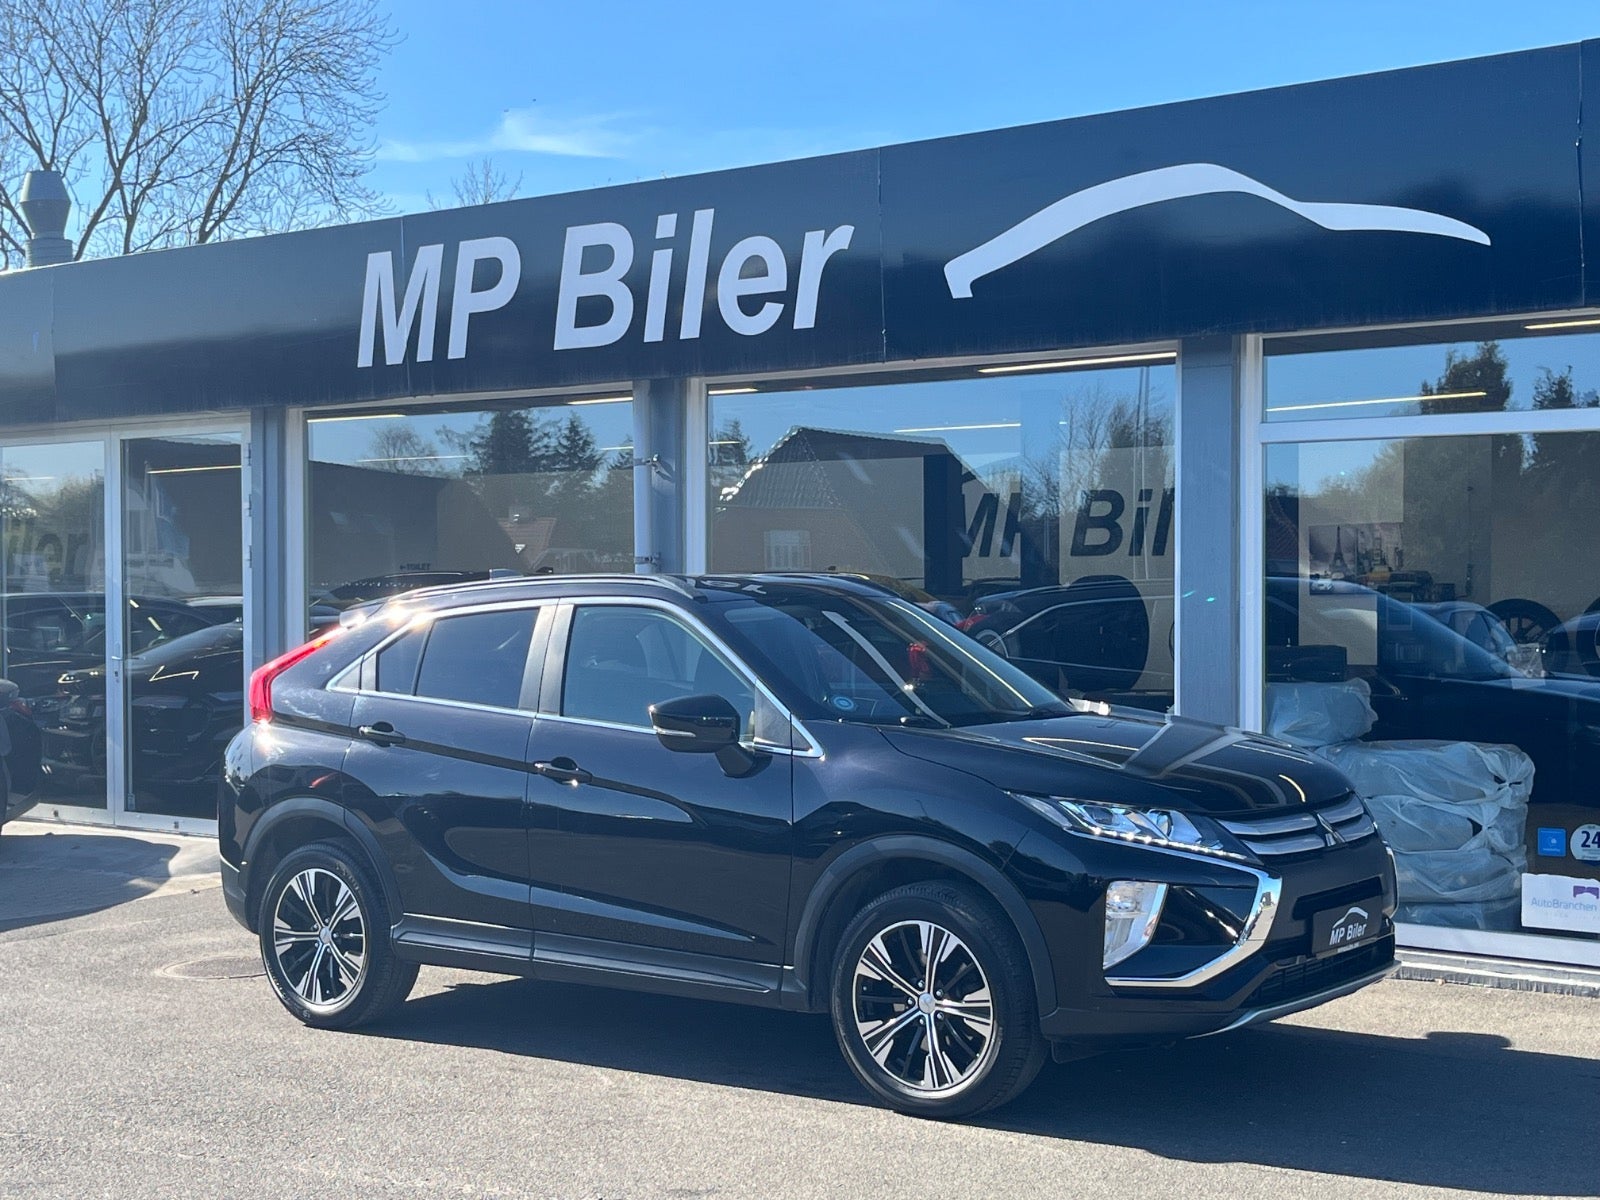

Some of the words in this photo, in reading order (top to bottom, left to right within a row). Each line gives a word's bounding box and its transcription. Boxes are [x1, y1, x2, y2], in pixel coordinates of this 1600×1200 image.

[357, 234, 522, 368] MP
[553, 208, 855, 351] Biler
[1530, 897, 1598, 912] AutoBranchen
[1329, 927, 1346, 946] MP
[1346, 922, 1367, 940] Biler
